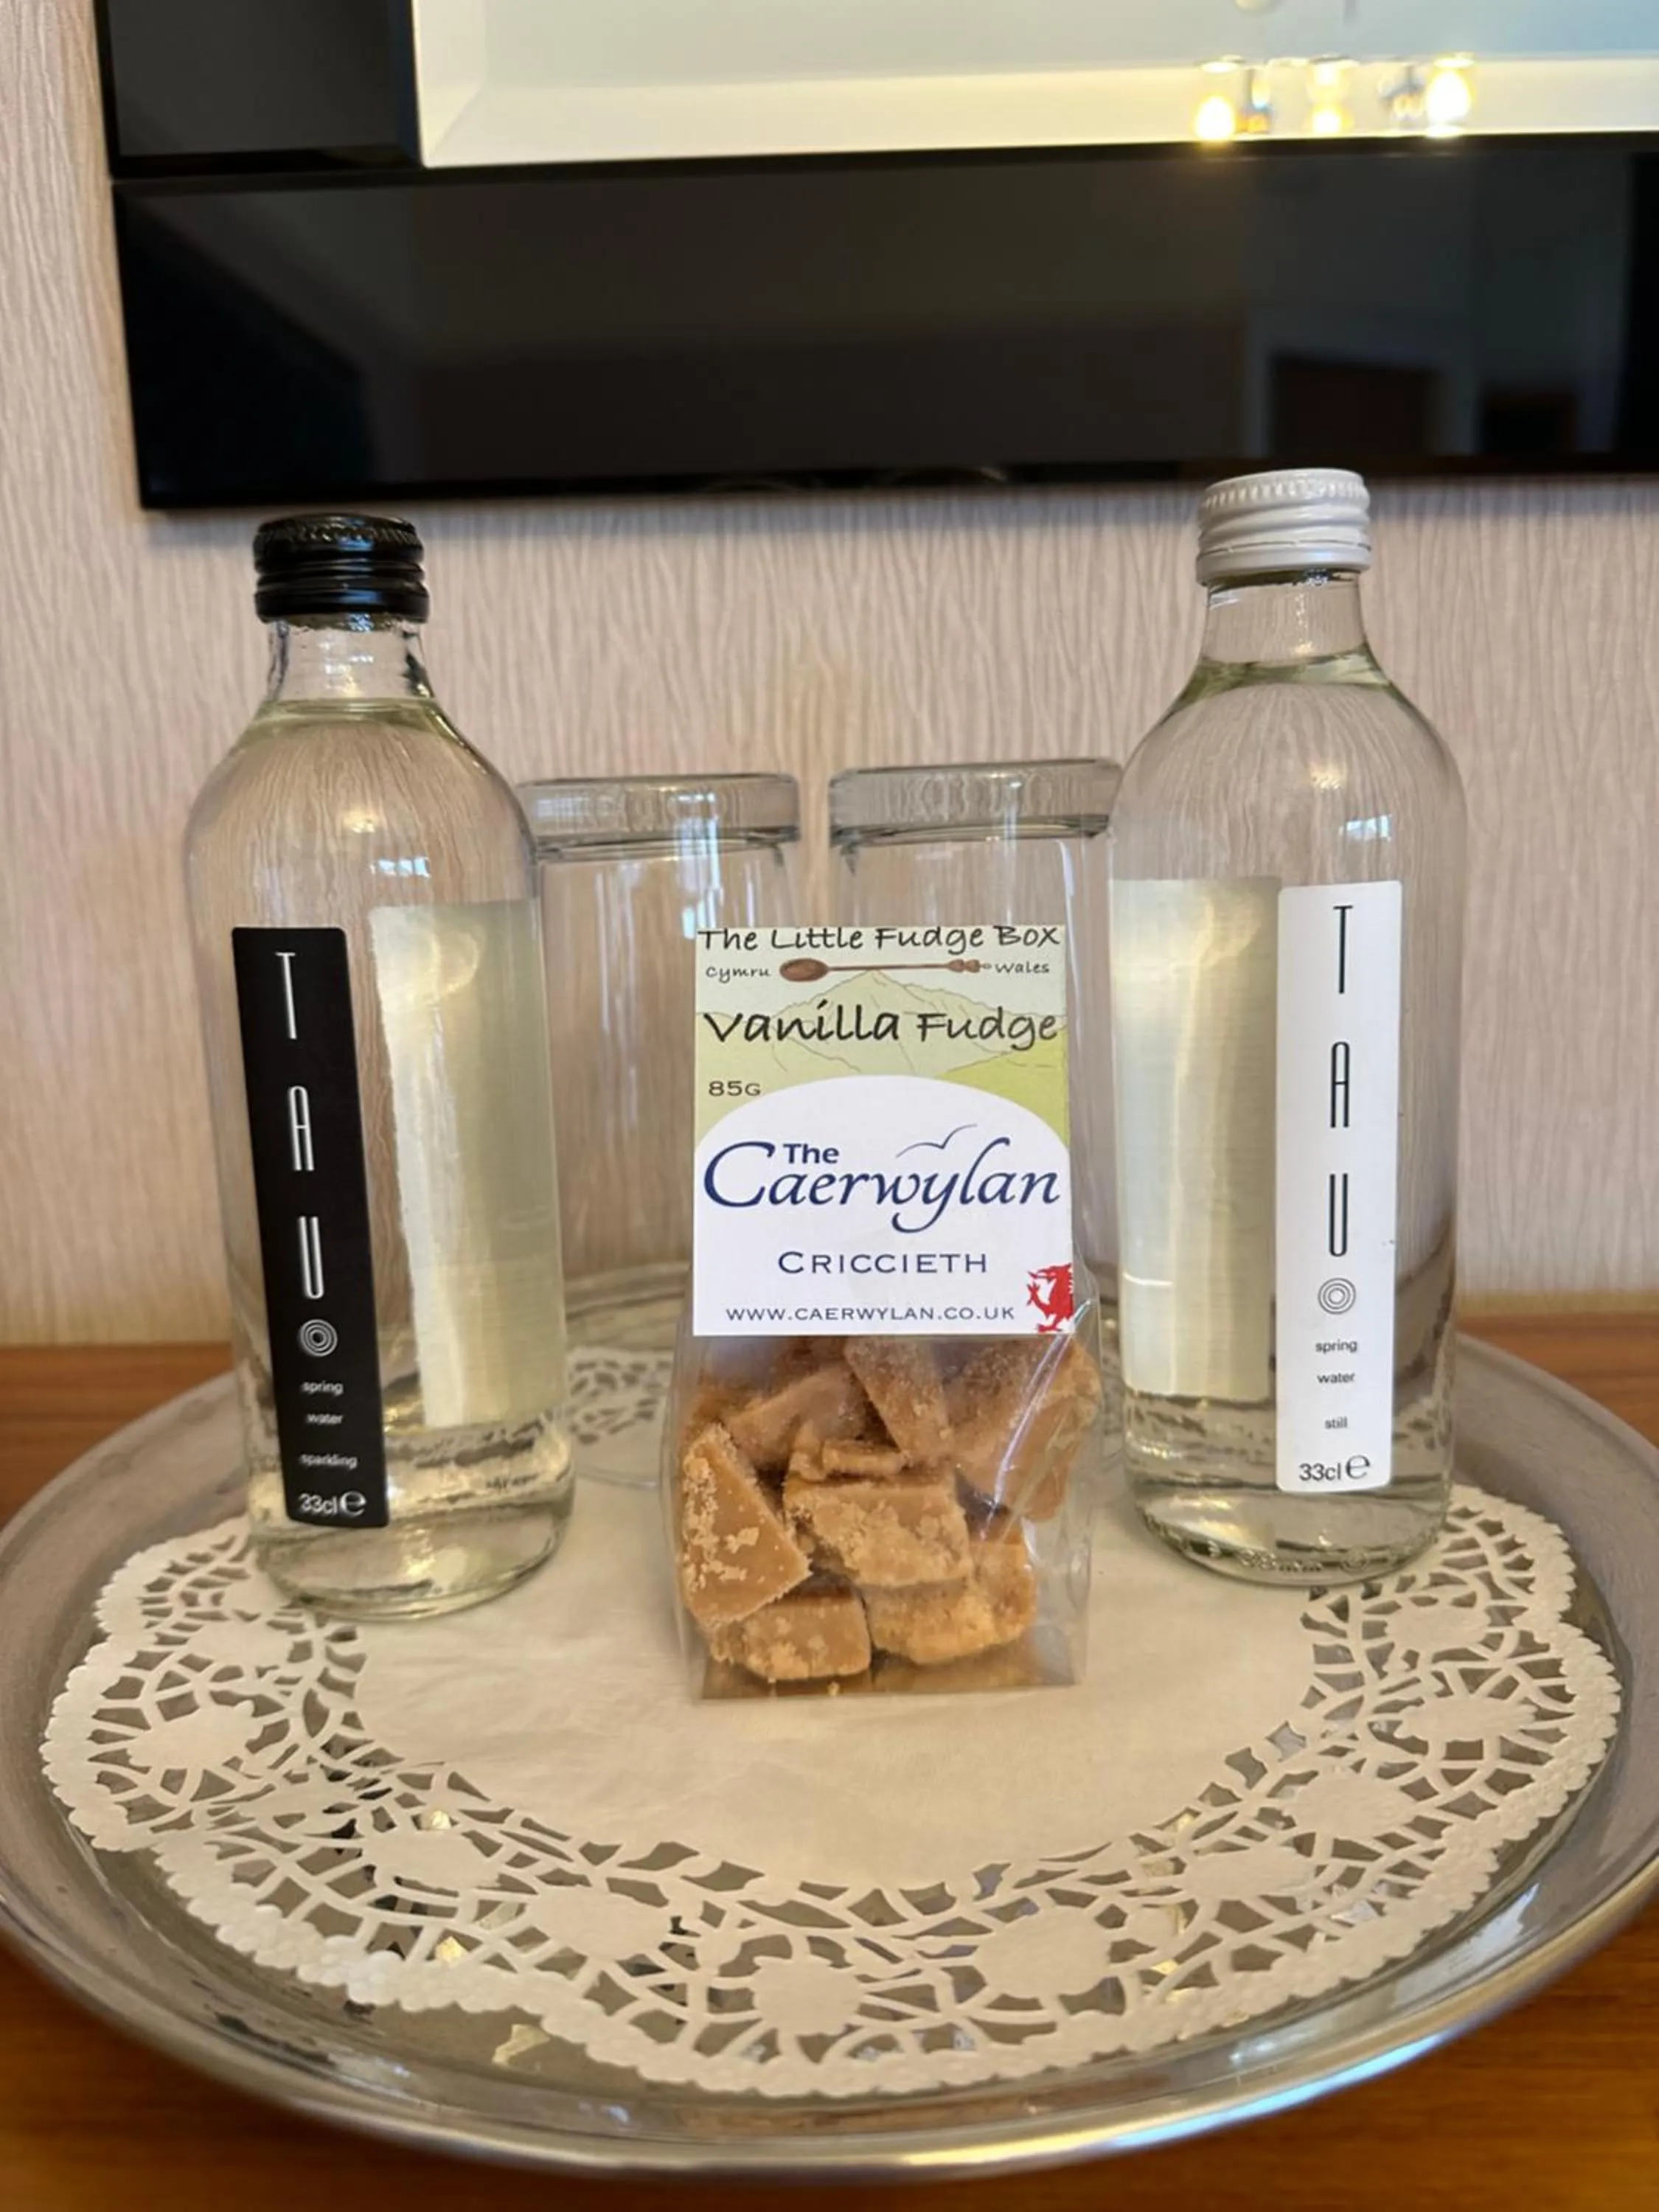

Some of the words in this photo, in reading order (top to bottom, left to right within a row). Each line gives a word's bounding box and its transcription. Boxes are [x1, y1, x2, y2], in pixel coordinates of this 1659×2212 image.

[698, 928, 758, 950] The
[771, 927, 863, 949] Little
[874, 925, 984, 955] Fudge
[993, 925, 1060, 947] Box
[706, 965, 771, 984] Cymru
[996, 960, 1050, 974] Wales
[704, 999, 900, 1043] Vanilla
[917, 1006, 1057, 1050] Fudge
[708, 1081, 761, 1097] 85G
[783, 1143, 839, 1165] The
[703, 1137, 1060, 1233] Caerwylan
[778, 1251, 987, 1274] CRICCIETH
[726, 1307, 1015, 1321] WWW.CAERWYLAN.CO.UK
[1315, 1339, 1358, 1353] spring
[1317, 1372, 1355, 1384] water
[302, 1380, 344, 1395] spring
[306, 1413, 343, 1425] water
[1325, 1416, 1348, 1429] still
